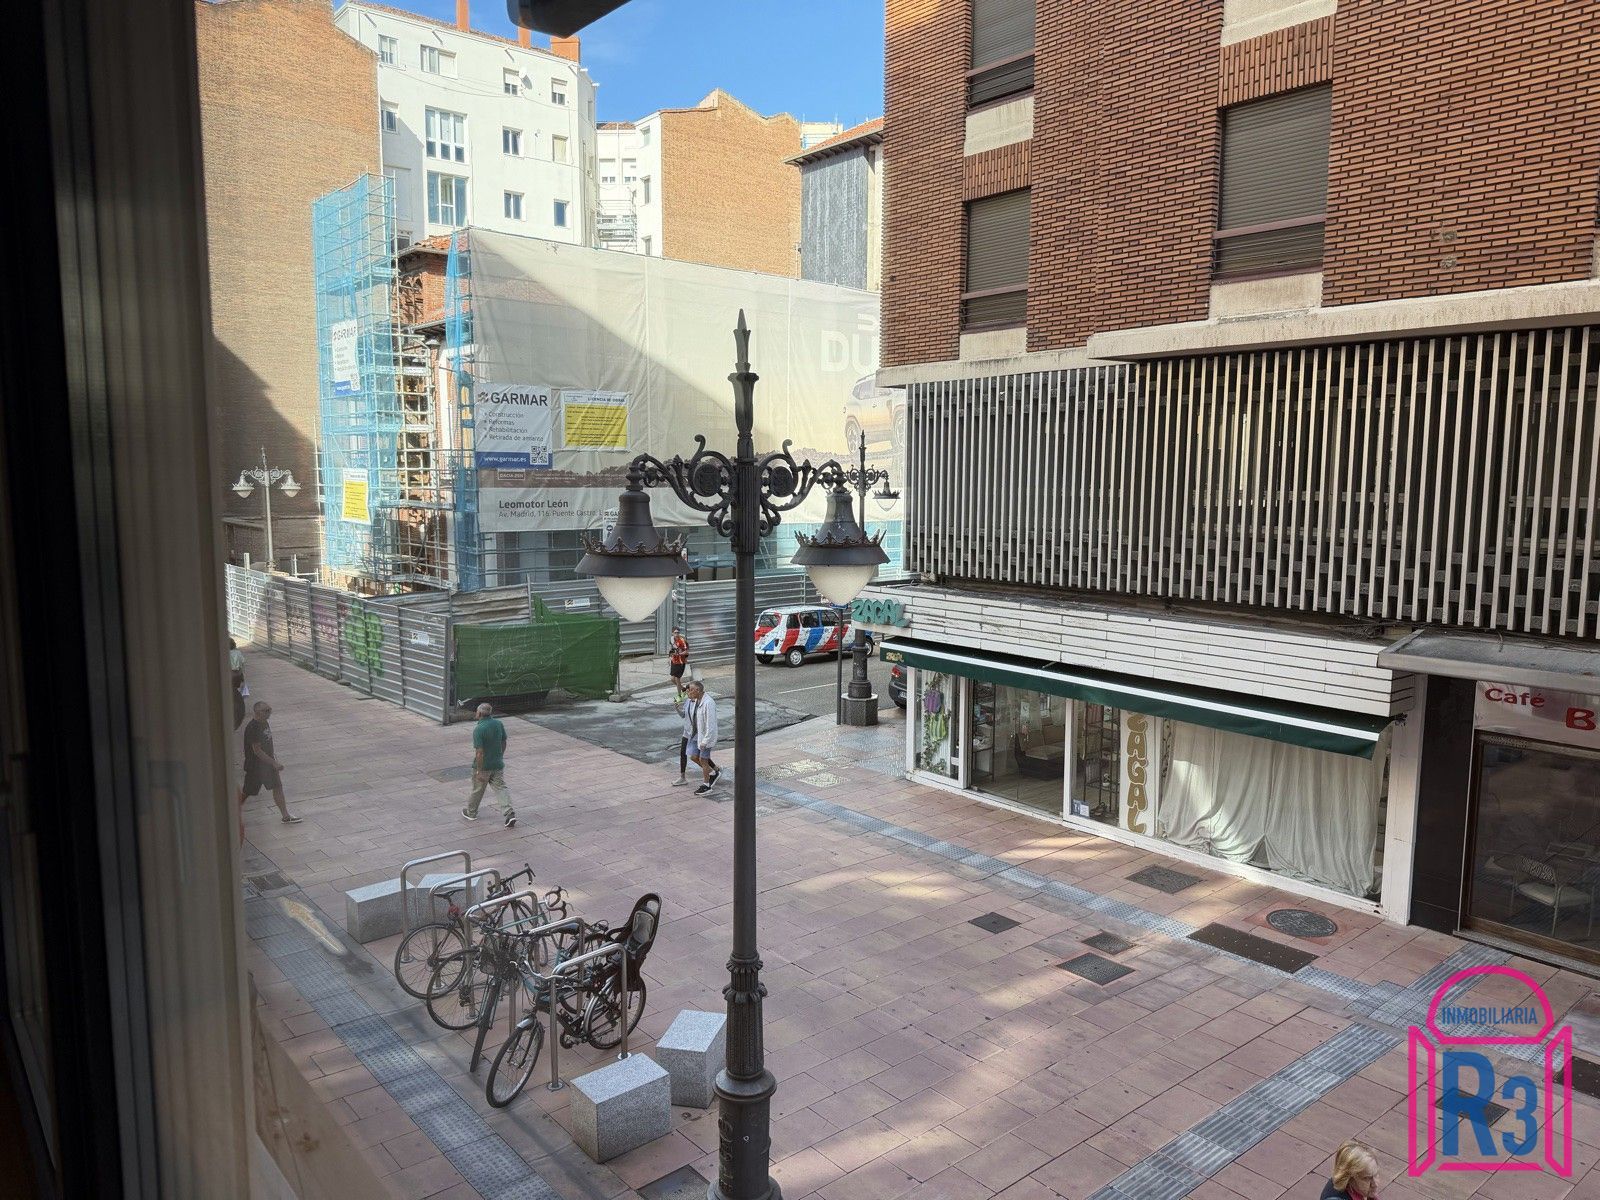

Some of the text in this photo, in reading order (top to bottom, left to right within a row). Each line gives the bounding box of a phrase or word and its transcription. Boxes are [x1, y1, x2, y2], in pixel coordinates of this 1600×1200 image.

[490, 392, 548, 406] GARMAR
[488, 426, 528, 434] Rehabilitación
[499, 499, 569, 509] Leomotor León
[553, 509, 575, 517] Puente
[1484, 687, 1546, 708] Café
